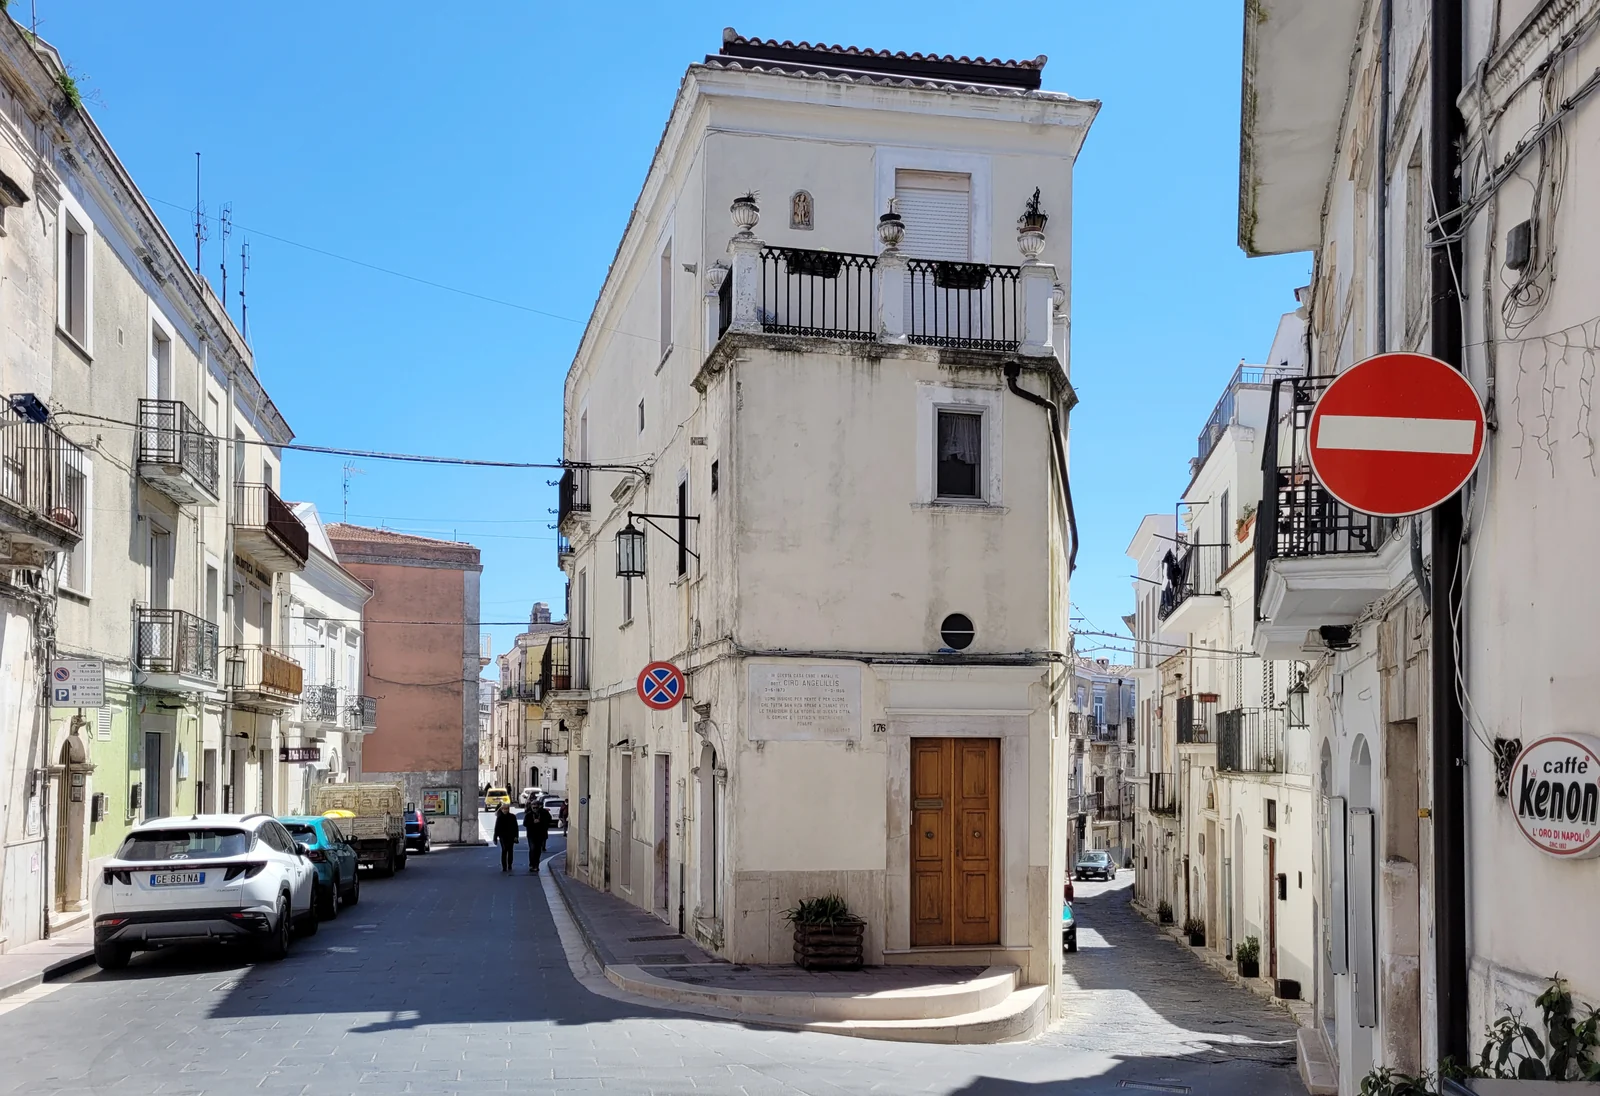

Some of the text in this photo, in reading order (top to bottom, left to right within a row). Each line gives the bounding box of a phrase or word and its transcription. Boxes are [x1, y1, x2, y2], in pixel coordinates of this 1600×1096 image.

[802, 679, 840, 687] ANGELILLIS
[872, 723, 887, 733] 176
[1518, 764, 1598, 825] kenon
[1553, 829, 1560, 840] DI
[156, 873, 199, 884] GE 861NA
